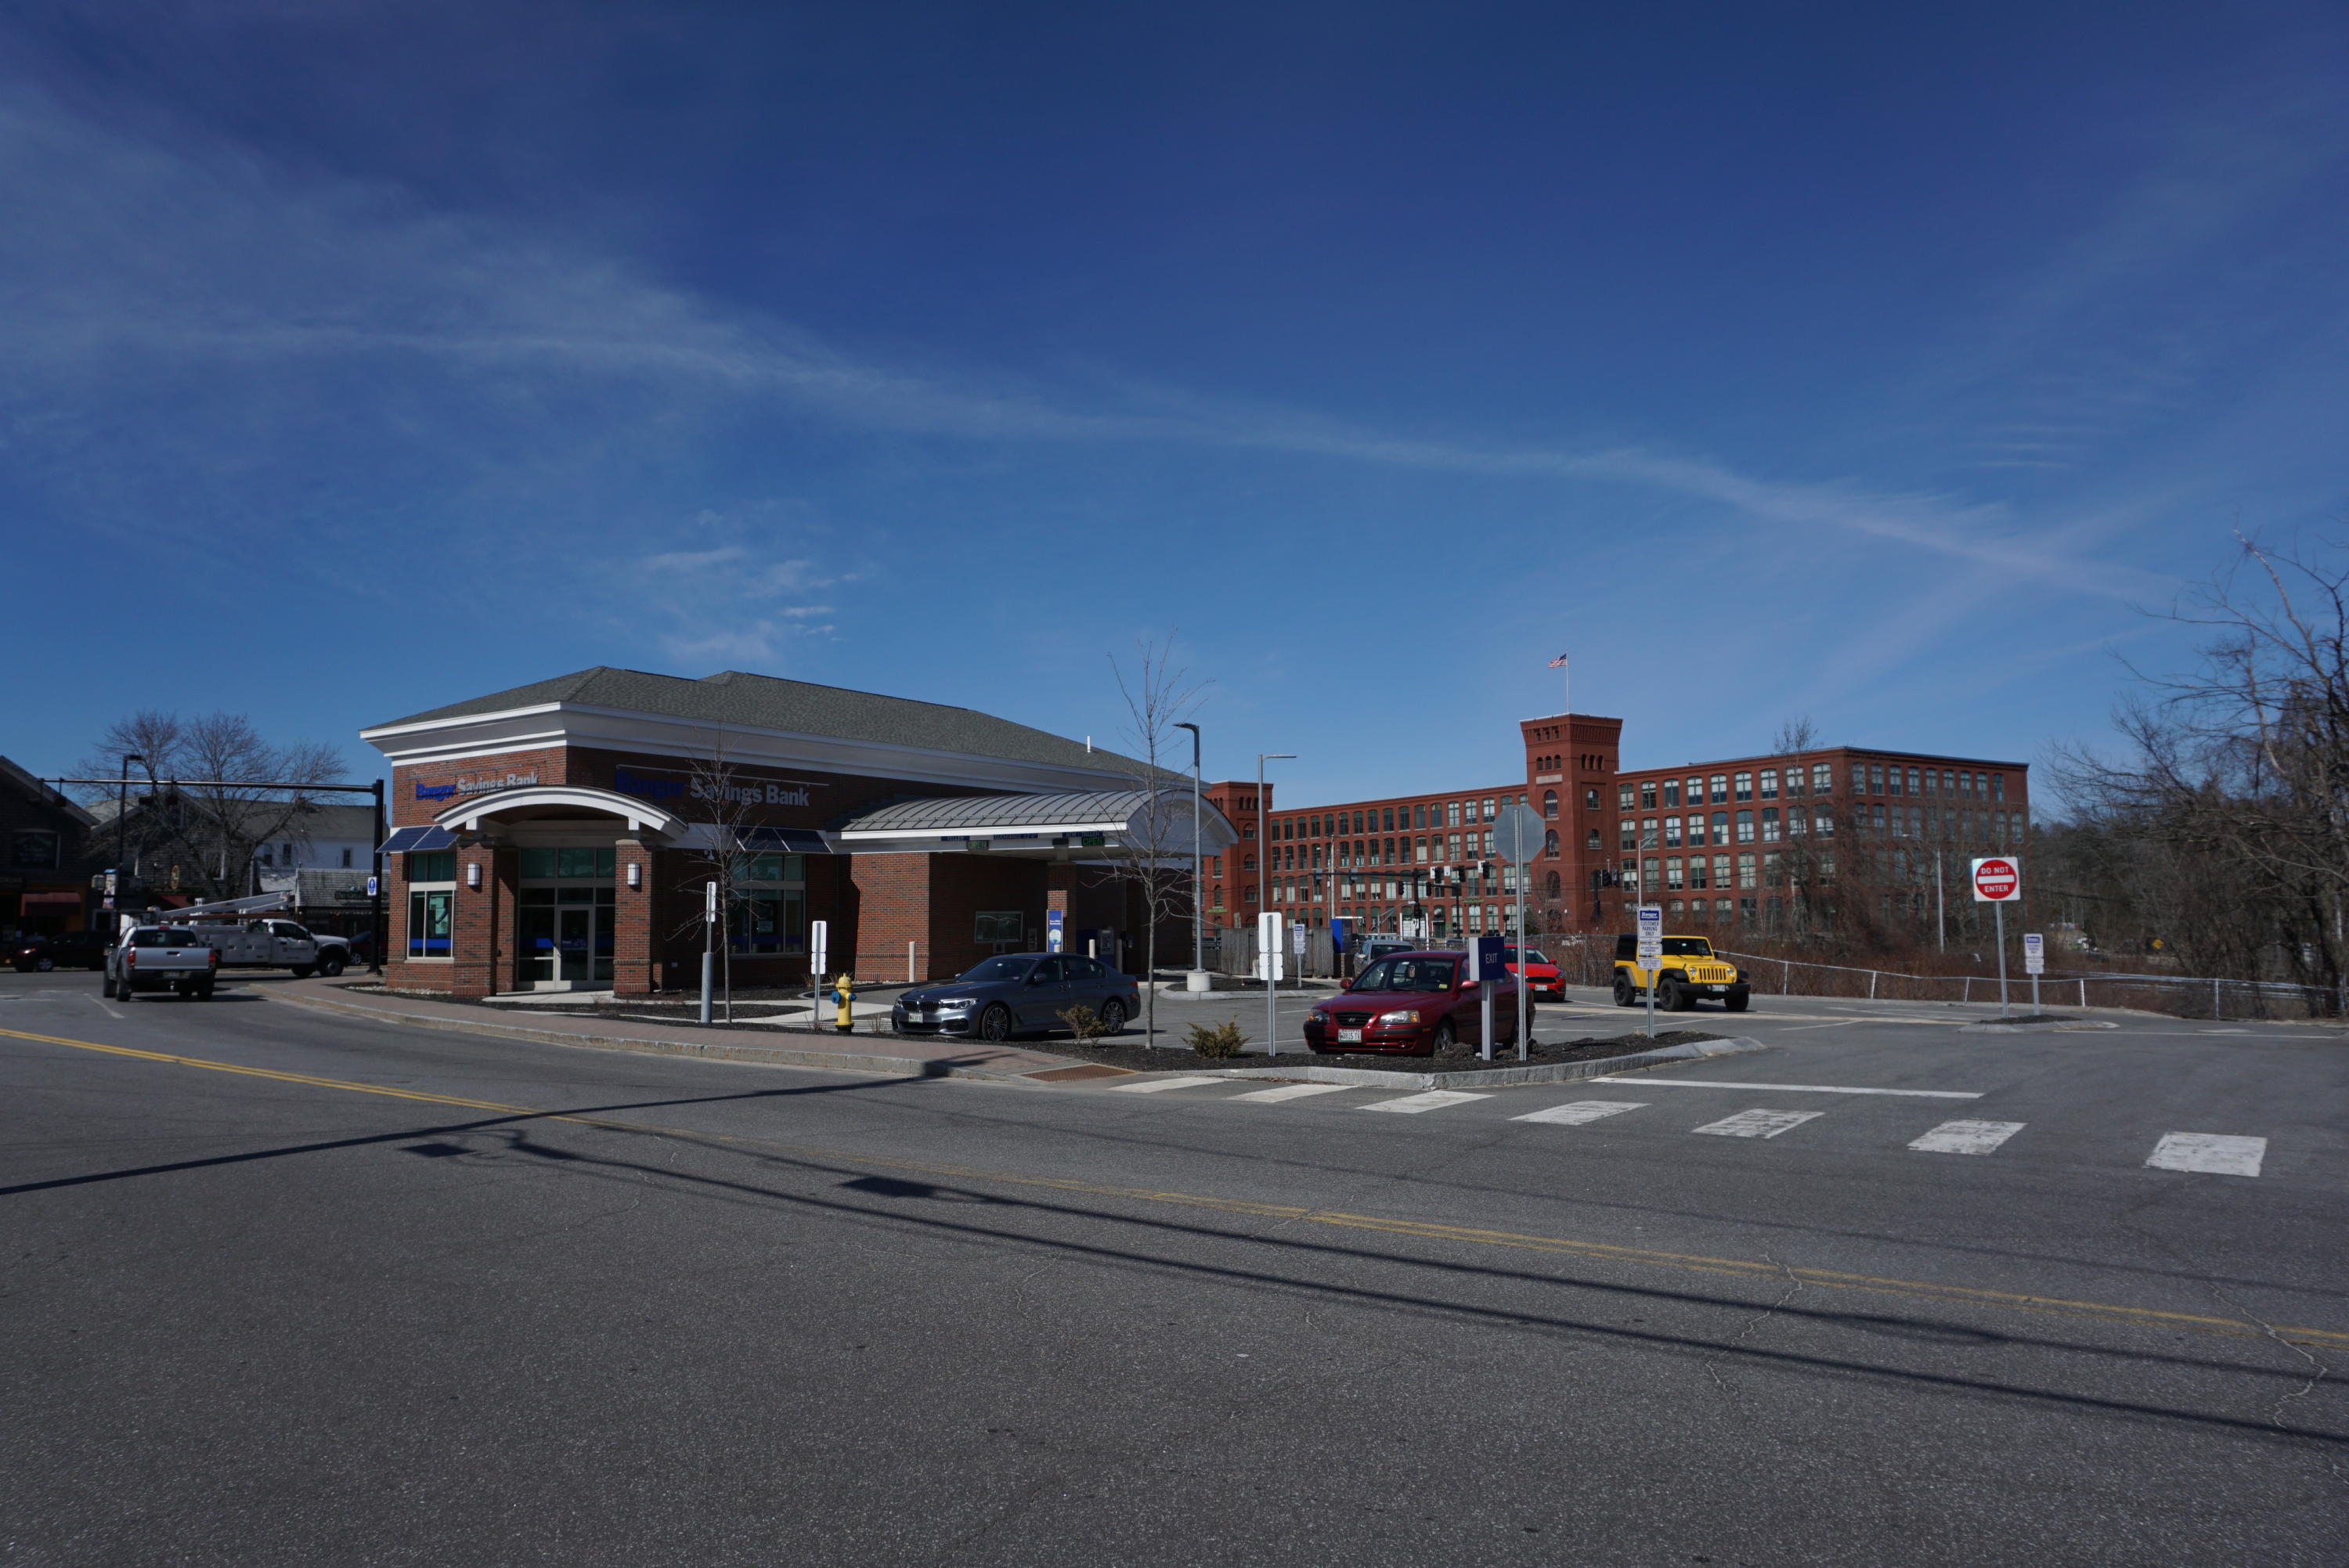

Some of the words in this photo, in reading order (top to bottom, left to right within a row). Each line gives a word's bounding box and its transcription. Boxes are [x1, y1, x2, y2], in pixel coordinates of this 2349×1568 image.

[416, 783, 456, 802] Bangor
[458, 777, 504, 795] Savings
[507, 771, 539, 787] Bank
[615, 770, 684, 798] Bangor
[690, 777, 763, 806] Savings
[767, 784, 810, 807] Bank
[1485, 953, 1497, 964] EXIT
